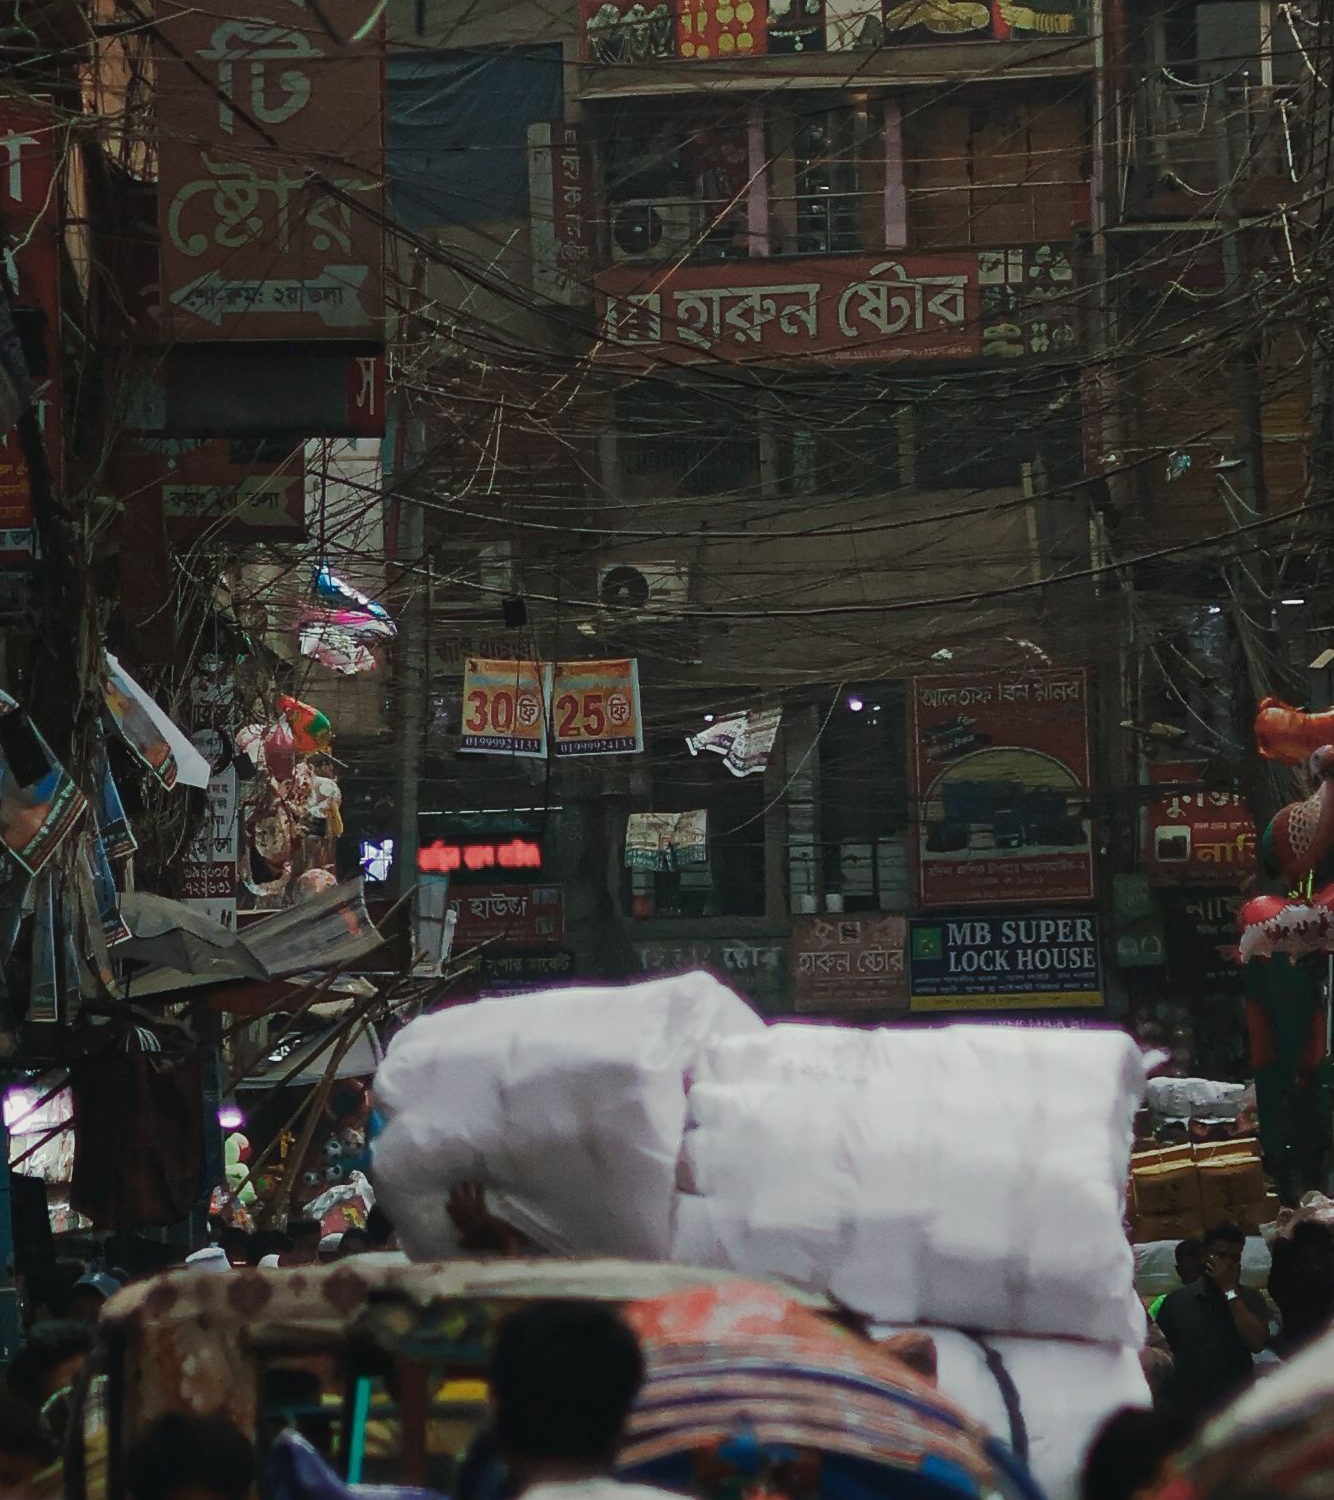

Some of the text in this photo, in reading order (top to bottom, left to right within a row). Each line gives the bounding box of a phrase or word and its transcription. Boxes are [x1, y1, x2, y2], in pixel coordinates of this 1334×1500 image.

[673, 283, 821, 348] হারুন
[466, 690, 514, 733] 30
[557, 694, 605, 738] 25
[946, 918, 1095, 946] MB SUPER
[948, 946, 1097, 973] LOCK HOUSE
